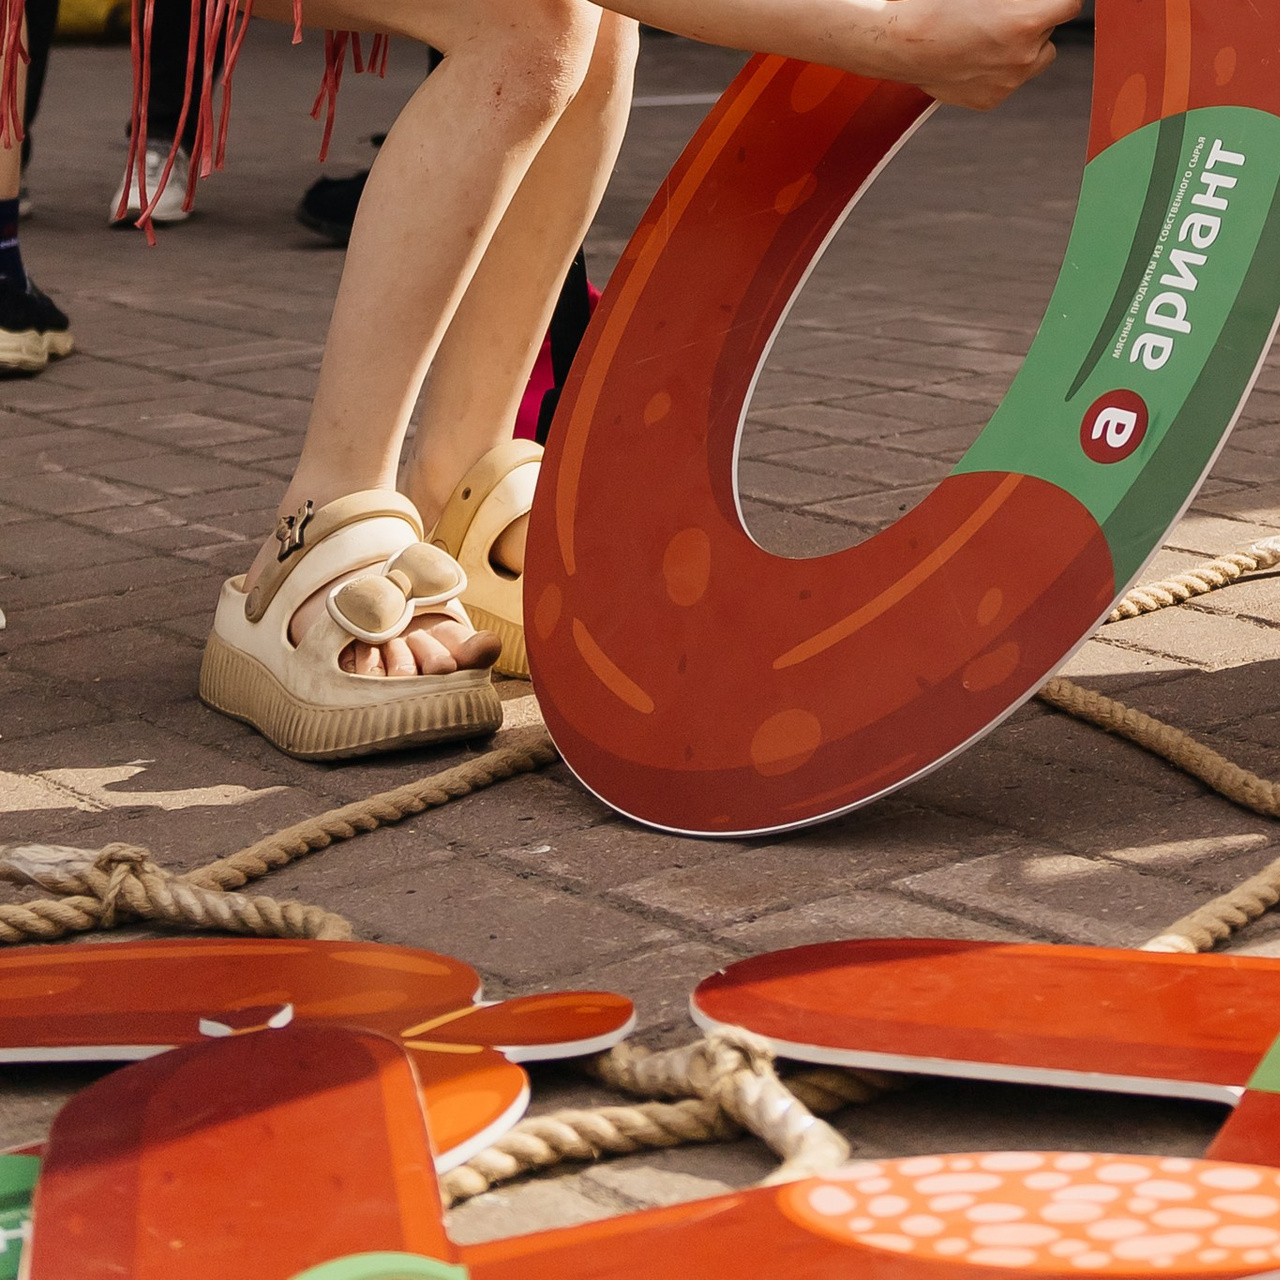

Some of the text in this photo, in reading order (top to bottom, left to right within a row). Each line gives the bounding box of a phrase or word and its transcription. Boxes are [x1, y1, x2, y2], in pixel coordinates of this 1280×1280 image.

[1112, 136, 1206, 359] МЯСНЫЕ ПРОДУКТЫ ИЗ СОБСТВЕННОГО СЫРЬЯ
[1129, 138, 1246, 371] ариант
